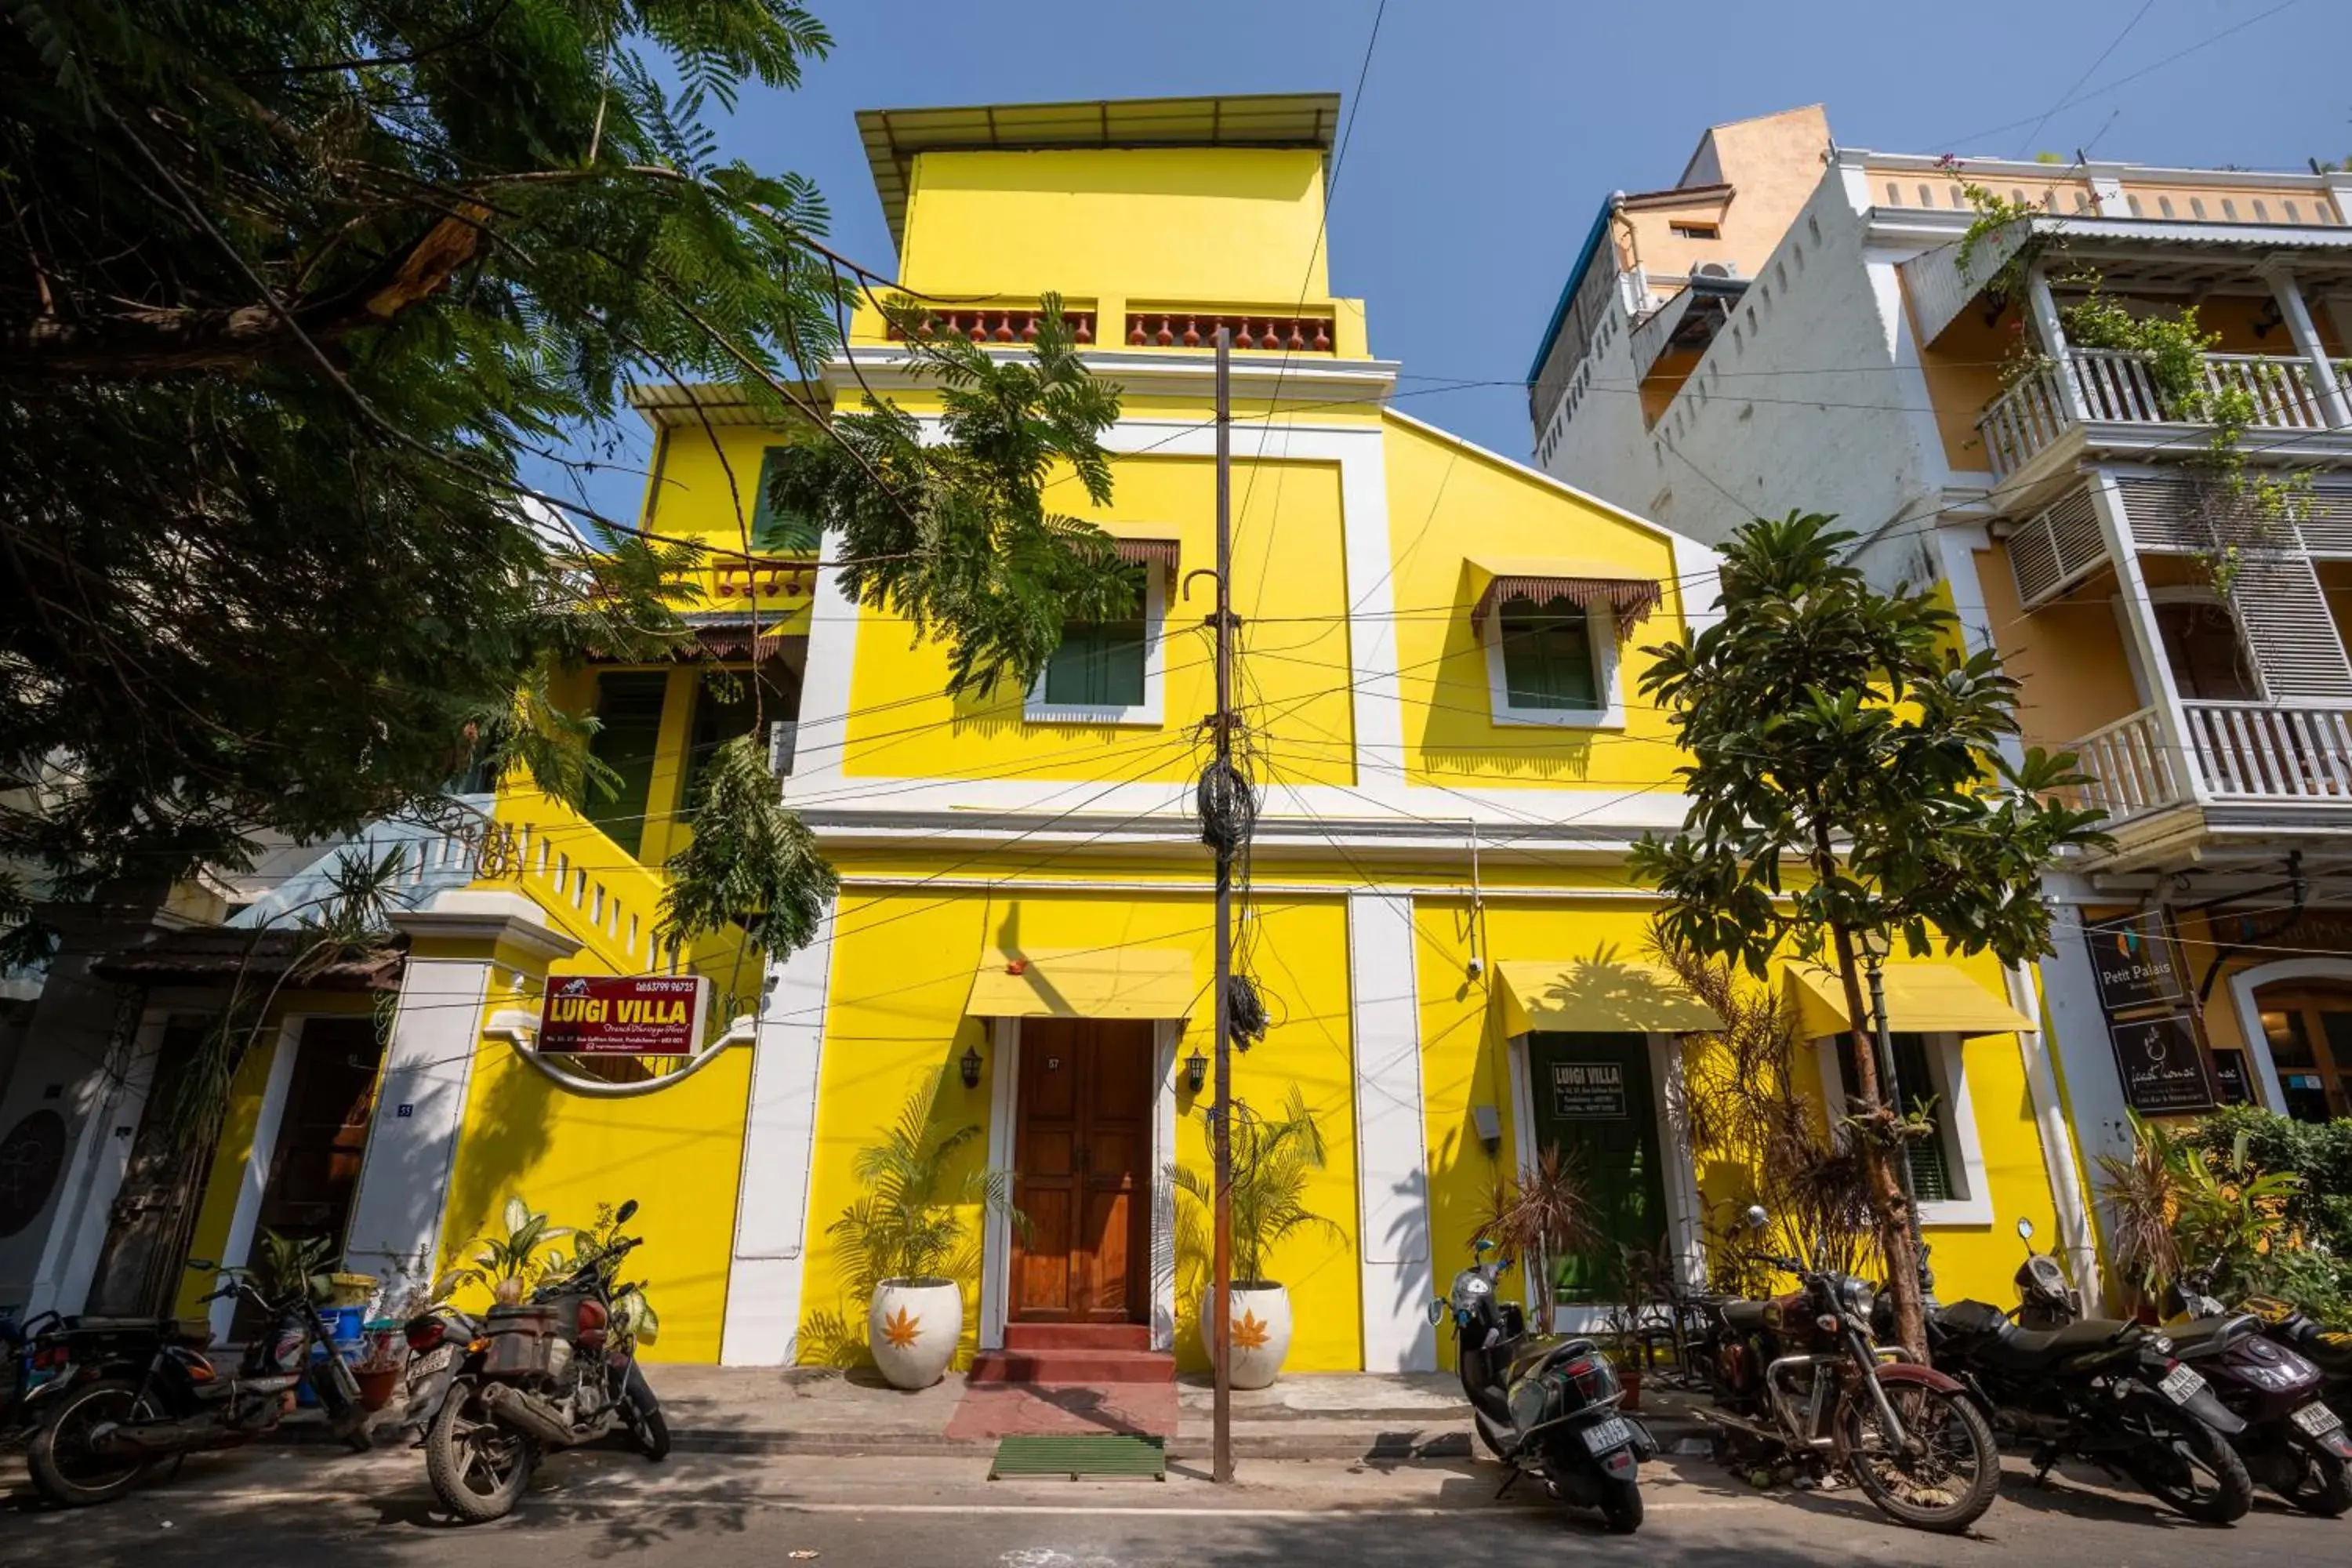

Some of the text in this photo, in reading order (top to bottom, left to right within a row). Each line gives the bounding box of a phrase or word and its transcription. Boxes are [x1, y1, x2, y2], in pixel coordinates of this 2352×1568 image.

[2101, 969, 2130, 985] Petit
[2132, 961, 2171, 979] Palais
[550, 997, 686, 1024] LUIGI VILLA
[1555, 1067, 1620, 1084] LUIGI VILLA
